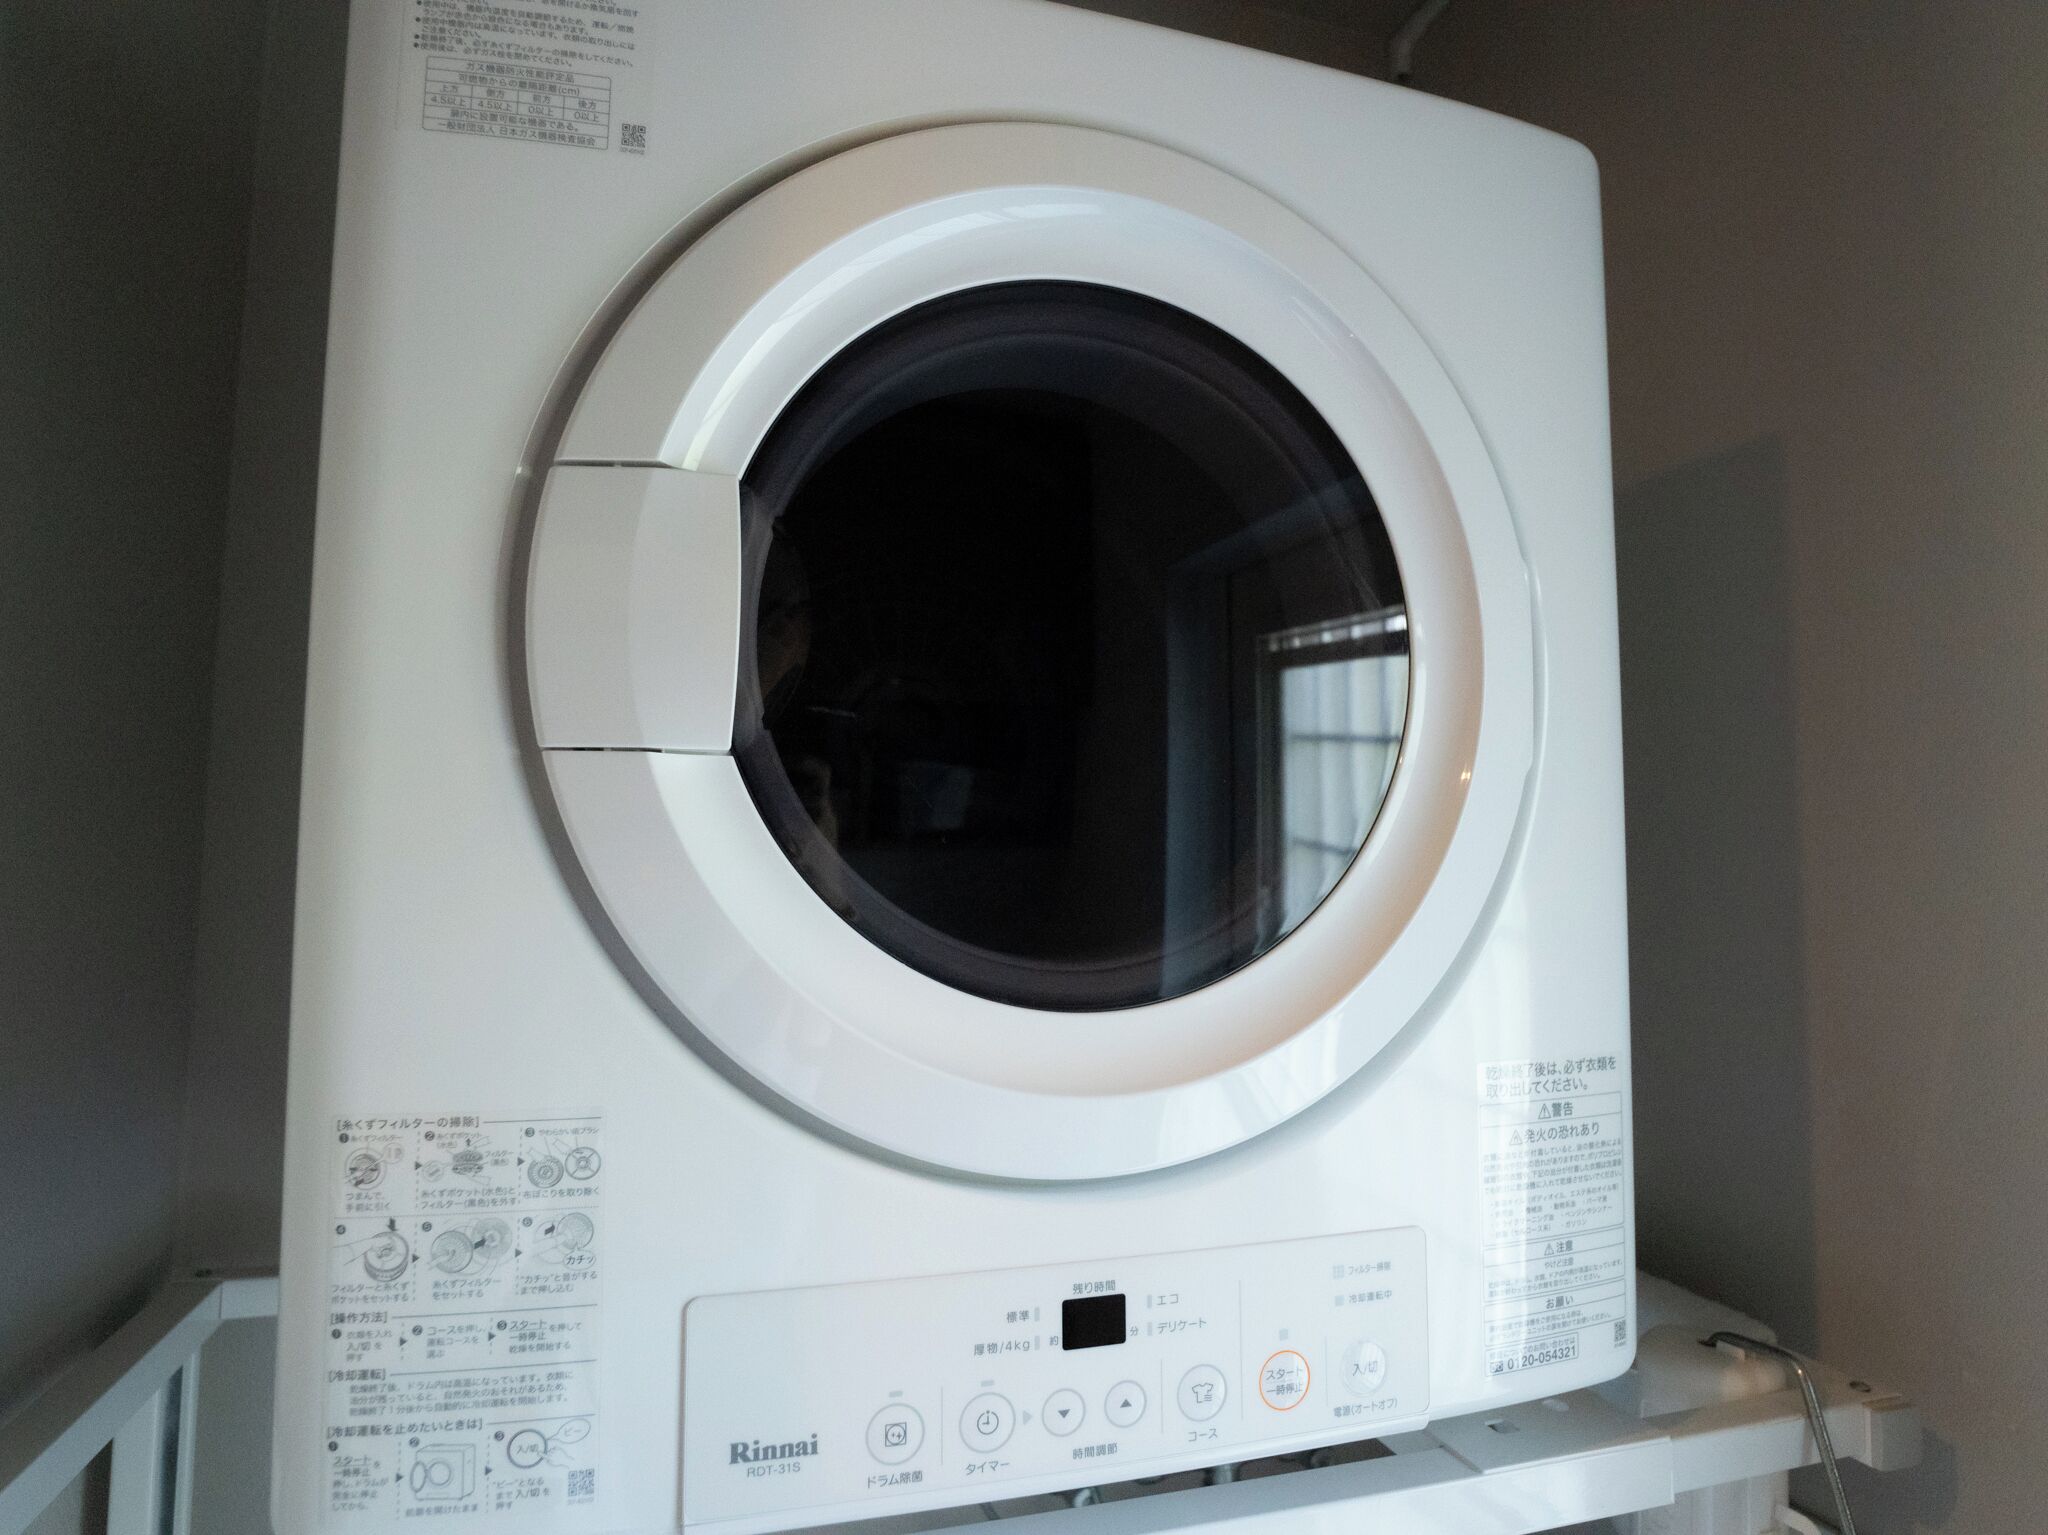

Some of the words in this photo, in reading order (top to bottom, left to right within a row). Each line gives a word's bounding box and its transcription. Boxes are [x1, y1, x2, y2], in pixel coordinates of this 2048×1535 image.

[1551, 1102, 1573, 1117] 警告
[1525, 1122, 1600, 1143] 発火の恐れあり
[1072, 1279, 1117, 1295] 残り時間
[1157, 1294, 1179, 1306] エコ
[1546, 1295, 1574, 1309] お願い
[1006, 1310, 1030, 1323] 標準
[1129, 1326, 1139, 1337] 分
[1157, 1317, 1208, 1334] デリケート
[974, 1338, 1031, 1356] 厚物/4kg
[1049, 1336, 1060, 1347] 約
[1507, 1345, 1576, 1370] 0120-054321
[1265, 1366, 1303, 1380] スタート
[1266, 1383, 1304, 1396] 一時停止
[1187, 1428, 1219, 1442] コース
[729, 1433, 819, 1465] Rinnai
[1072, 1442, 1118, 1460] 時間調節
[746, 1461, 801, 1478] RDT-31S
[965, 1459, 1011, 1476] タイマー
[866, 1470, 923, 1489] ドラム除菌
